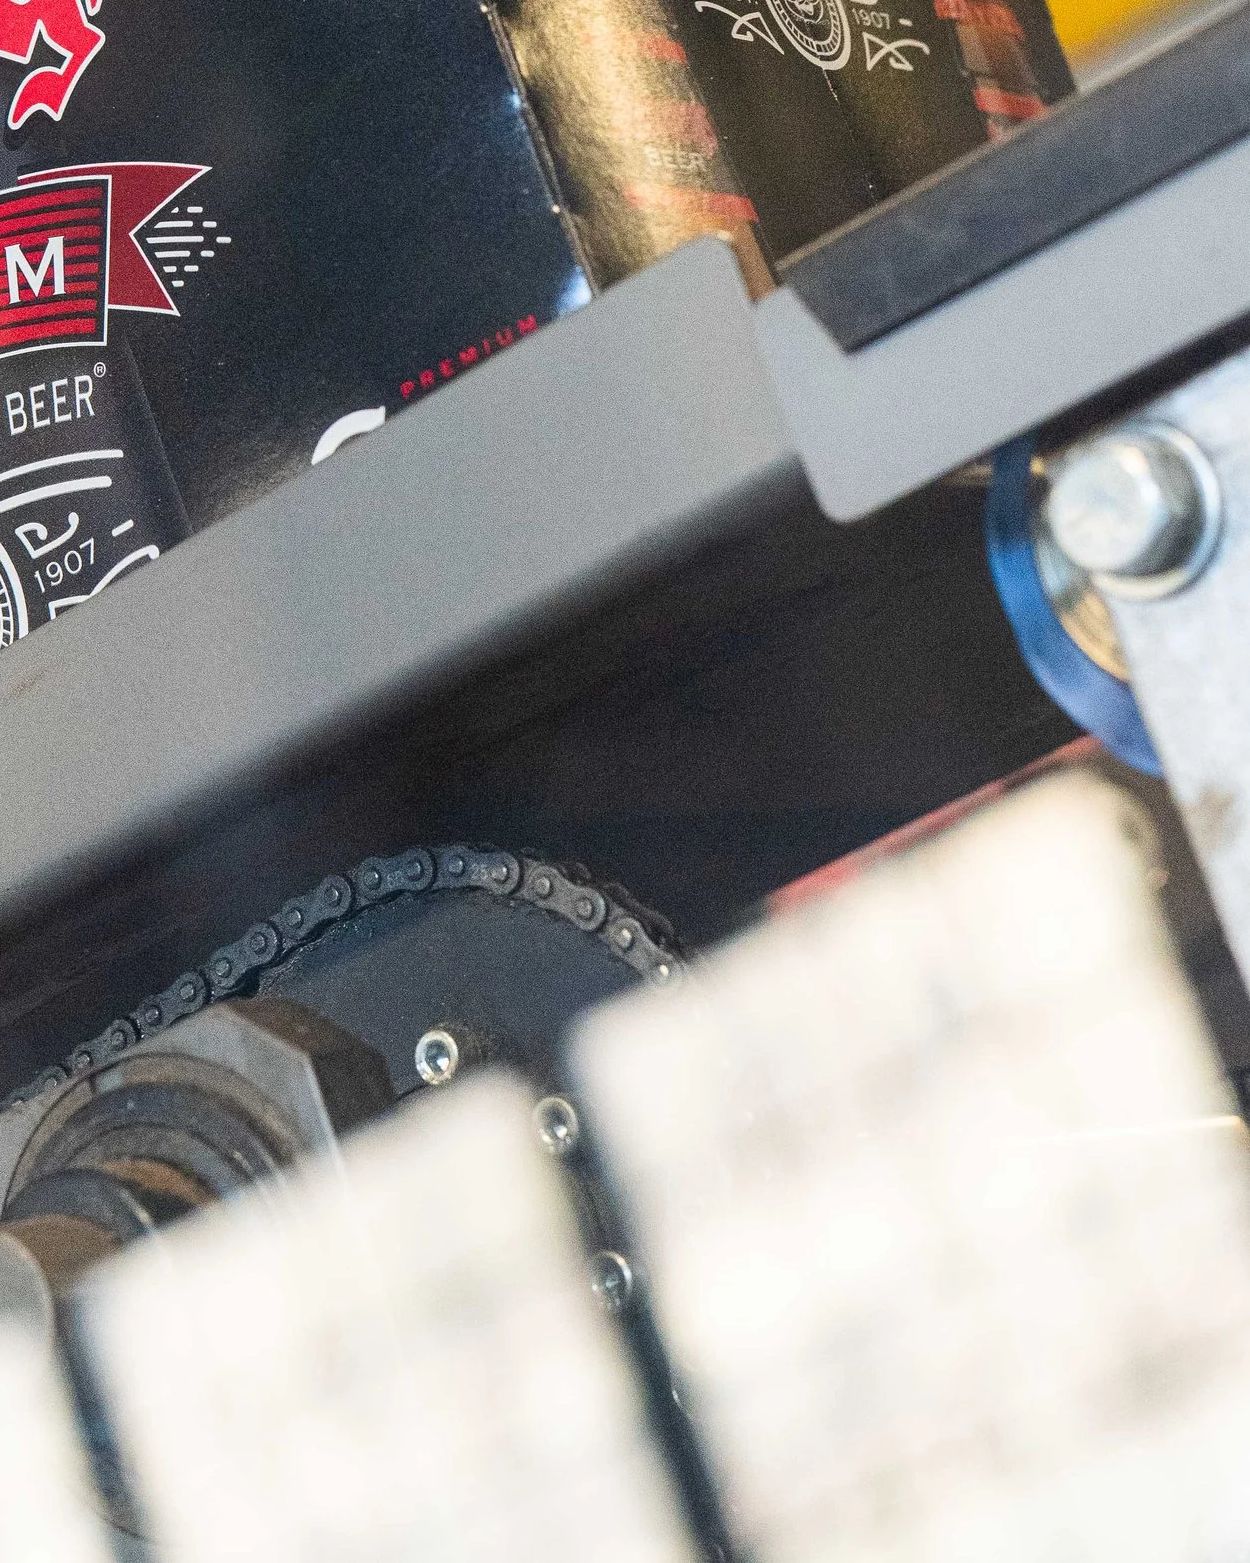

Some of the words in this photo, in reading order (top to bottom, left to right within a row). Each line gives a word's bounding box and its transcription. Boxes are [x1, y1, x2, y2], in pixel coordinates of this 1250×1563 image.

[851, 8, 892, 30] 1907
[399, 313, 539, 399] PREMIUM
[33, 538, 99, 595] 1907
